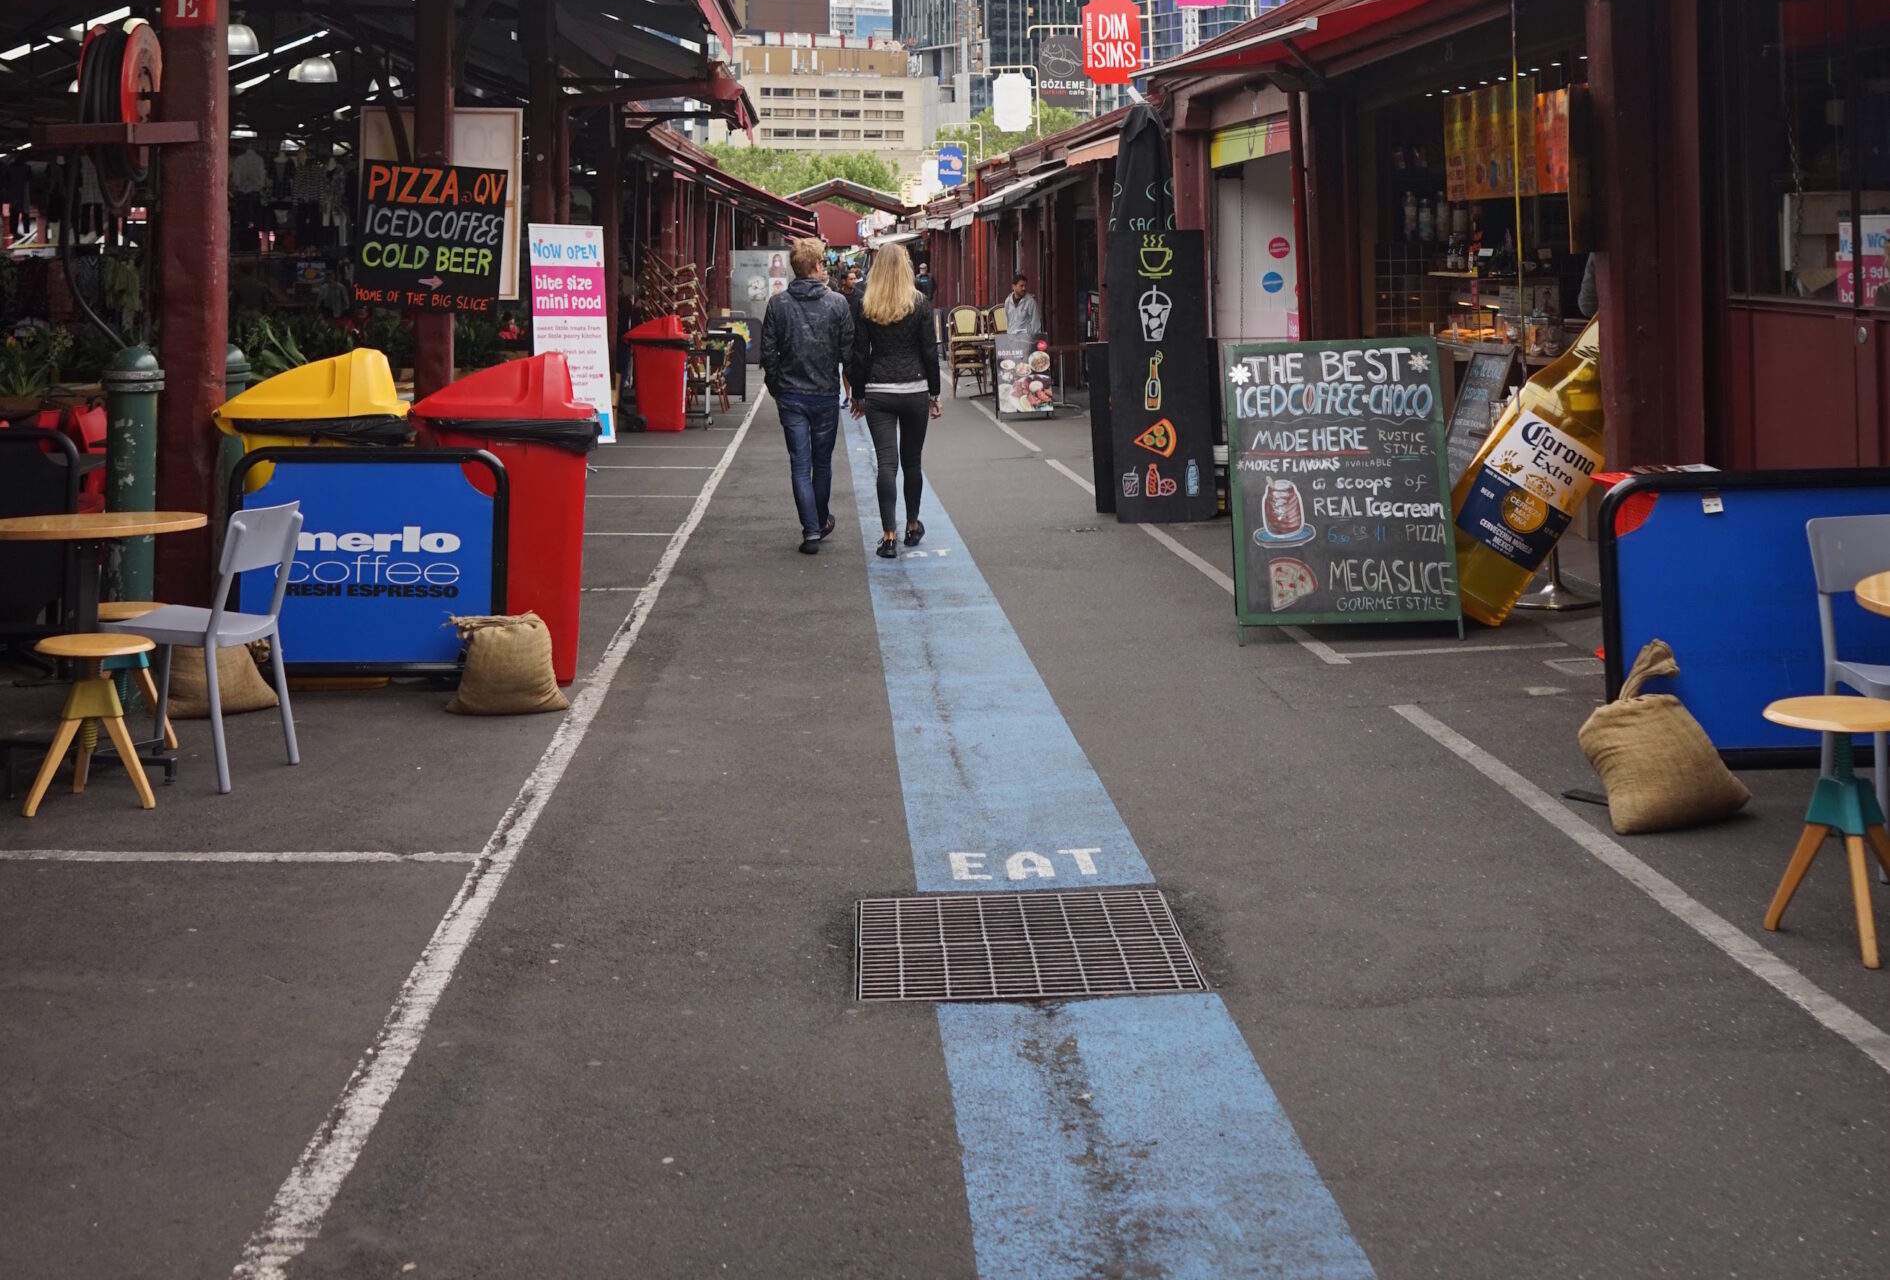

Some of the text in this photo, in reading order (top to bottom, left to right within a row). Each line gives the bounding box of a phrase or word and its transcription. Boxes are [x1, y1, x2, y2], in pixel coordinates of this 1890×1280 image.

[1098, 13, 1129, 40] DIM
[1093, 41, 1136, 68] SIMS
[1041, 79, 1085, 89] GÖZLEME
[368, 165, 459, 205] PIZZA
[473, 173, 507, 205] QV
[362, 241, 493, 276] COLD BEER
[533, 242, 597, 260] NOW OPEN
[535, 274, 592, 291] bite size
[387, 290, 400, 303] OF
[406, 291, 427, 306] THE
[432, 294, 452, 307] BIG
[536, 293, 601, 310] mini food
[1241, 347, 1411, 384] THE BEST
[1235, 384, 1287, 418] ICED
[1288, 382, 1365, 417] COFFEE
[1369, 384, 1433, 418] CHOCO
[1252, 427, 1369, 452] MADE HERE
[1521, 421, 1596, 476] Corona
[1283, 456, 1341, 473] FLAVOURS
[1345, 458, 1392, 468] AVAILABLE
[1532, 450, 1574, 486] Extra
[1404, 474, 1428, 492] of
[1480, 487, 1495, 500] BEER
[1314, 496, 1363, 517] REAL
[1510, 495, 1542, 519] CERVEZA
[1525, 496, 1535, 507] LA
[1510, 513, 1527, 527] FINA
[1405, 522, 1447, 544] PIZZA
[275, 554, 461, 585] coffee
[1329, 559, 1456, 596] MEGA SLICE
[280, 584, 459, 599] RESH ESPRESSO
[1337, 596, 1445, 612] GOURMET STYLE
[950, 848, 1102, 880] EAT
